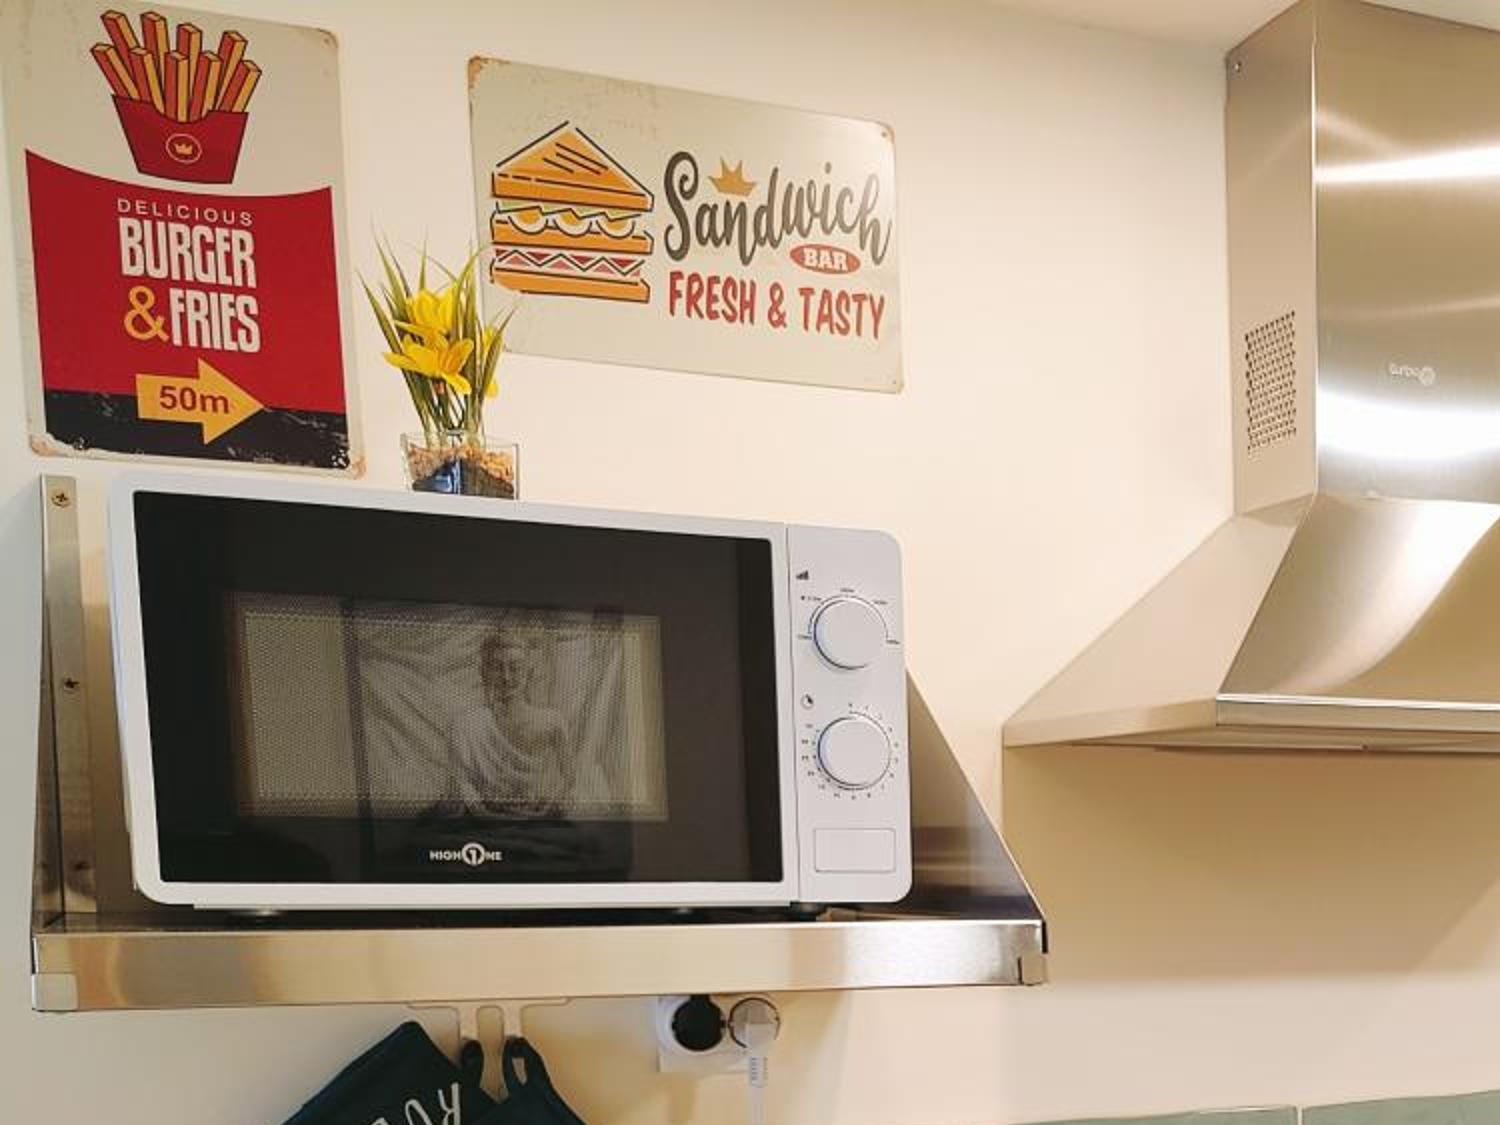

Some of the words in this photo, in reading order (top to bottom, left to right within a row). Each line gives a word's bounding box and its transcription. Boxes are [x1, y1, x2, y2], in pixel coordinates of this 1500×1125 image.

[117, 198, 254, 227] DELICIOUS
[664, 150, 893, 267] Sandwich
[118, 216, 258, 289] BURGER
[803, 247, 848, 271] BAR
[124, 285, 169, 342] &
[169, 287, 261, 353] FRIES
[669, 270, 756, 325] FRESH
[766, 286, 789, 329] &
[799, 287, 886, 340] TASTY
[159, 385, 230, 415] 50m
